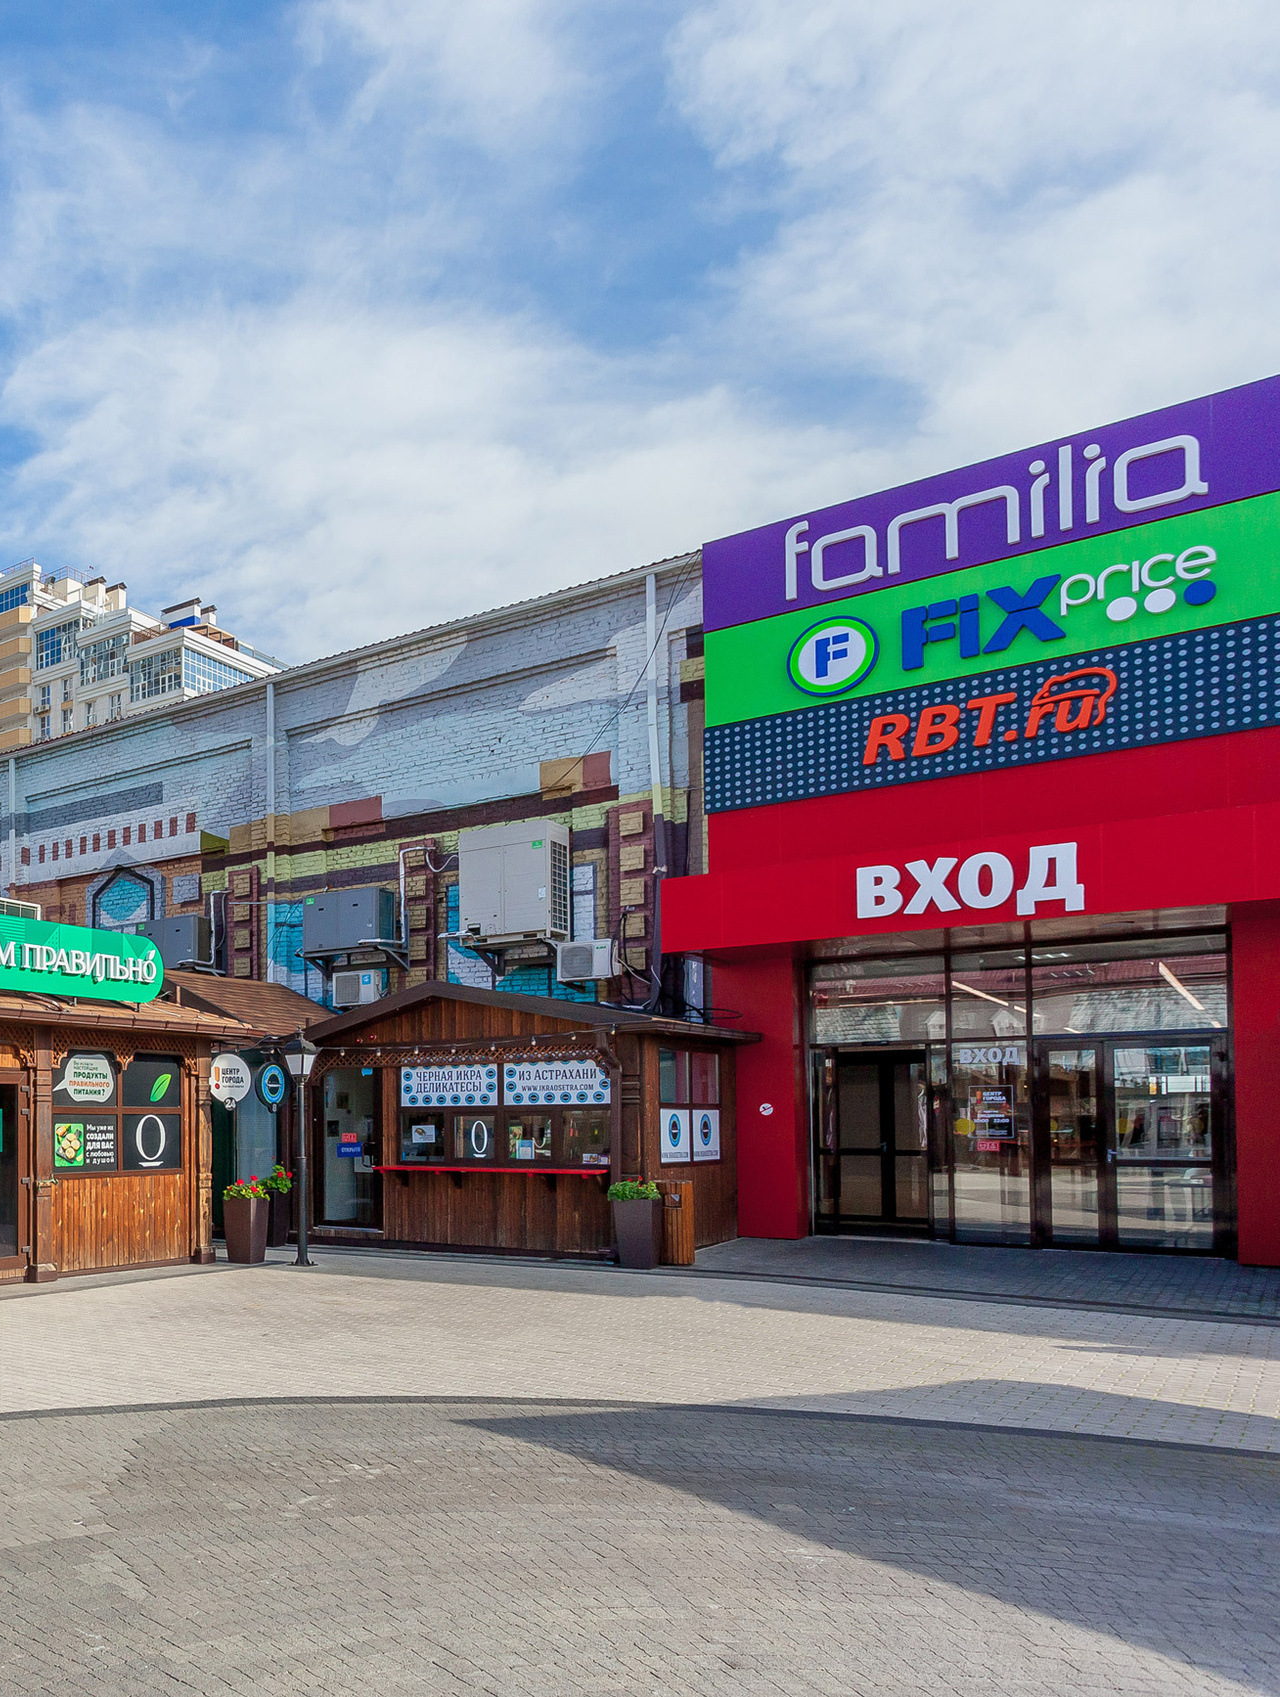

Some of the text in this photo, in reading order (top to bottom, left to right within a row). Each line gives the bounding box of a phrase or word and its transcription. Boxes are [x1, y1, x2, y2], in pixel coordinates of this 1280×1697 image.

[785, 434, 1209, 601] familia
[1060, 545, 1217, 617] price
[862, 690, 1098, 766] RBT.ru
[856, 841, 1086, 919] ВХОД
[22, 943, 158, 984] ПРАВИЛЬНО
[960, 1047, 1020, 1065] ВХОД
[73, 1071, 108, 1080] ПРОДУКТЫ
[222, 1076, 245, 1084] ГОРОДА
[415, 1069, 482, 1081] ЧЕРНАЯ ИКРА
[519, 1068, 597, 1081] ИЗ АСТРАХАНИ
[68, 1080, 110, 1088] ПРАВИЛЬНОГО
[415, 1082, 482, 1094] ДЕЛИКАТЕСЫ
[521, 1084, 594, 1092] WWW.IKRAOSETRA.COM
[86, 1132, 114, 1140] СОЗДАЛИ
[86, 1141, 114, 1150] ДЛЯ ВАС
[92, 1157, 115, 1165] душой
